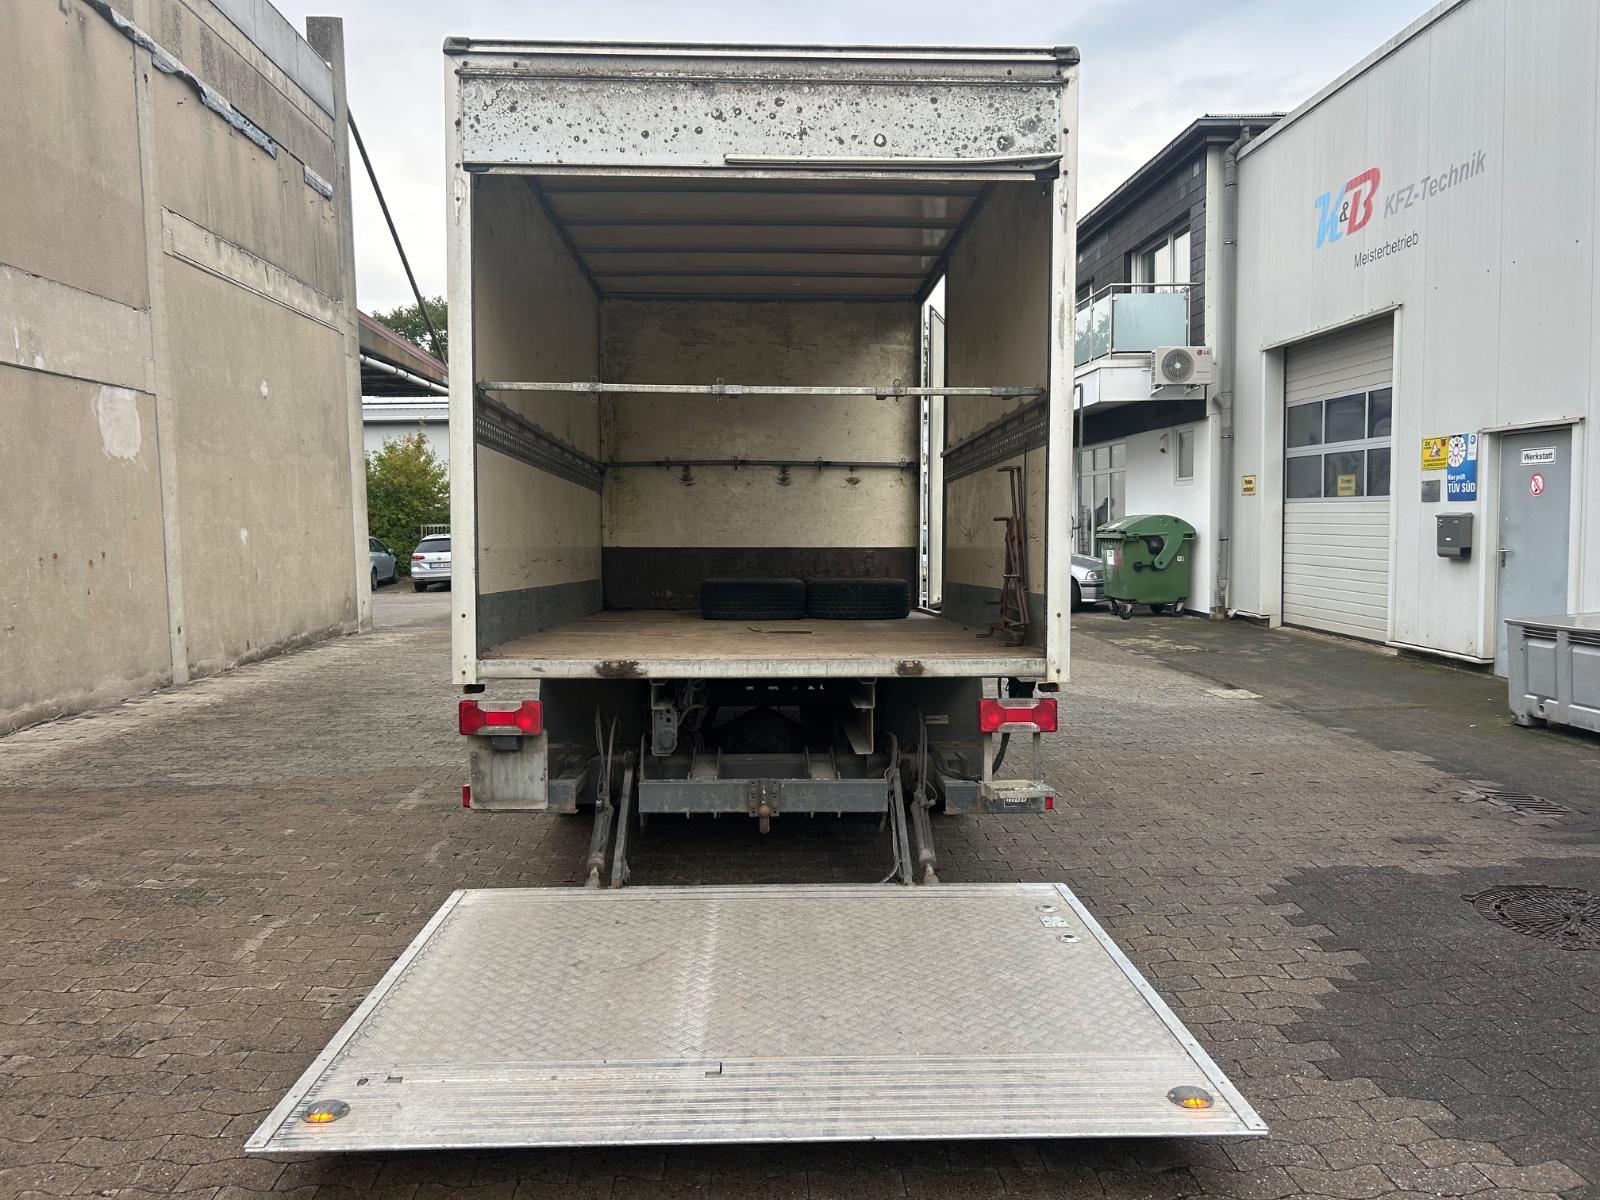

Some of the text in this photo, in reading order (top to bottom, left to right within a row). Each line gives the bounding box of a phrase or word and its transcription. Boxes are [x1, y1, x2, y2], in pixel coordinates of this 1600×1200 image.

[1313, 149, 1487, 250] K&B KFZ-Technik
[1354, 230, 1419, 269] Meisterbetrieb
[1524, 452, 1553, 461] Werkstatt
[1448, 481, 1460, 493] TÜV
[1461, 480, 1475, 493] SÜD
